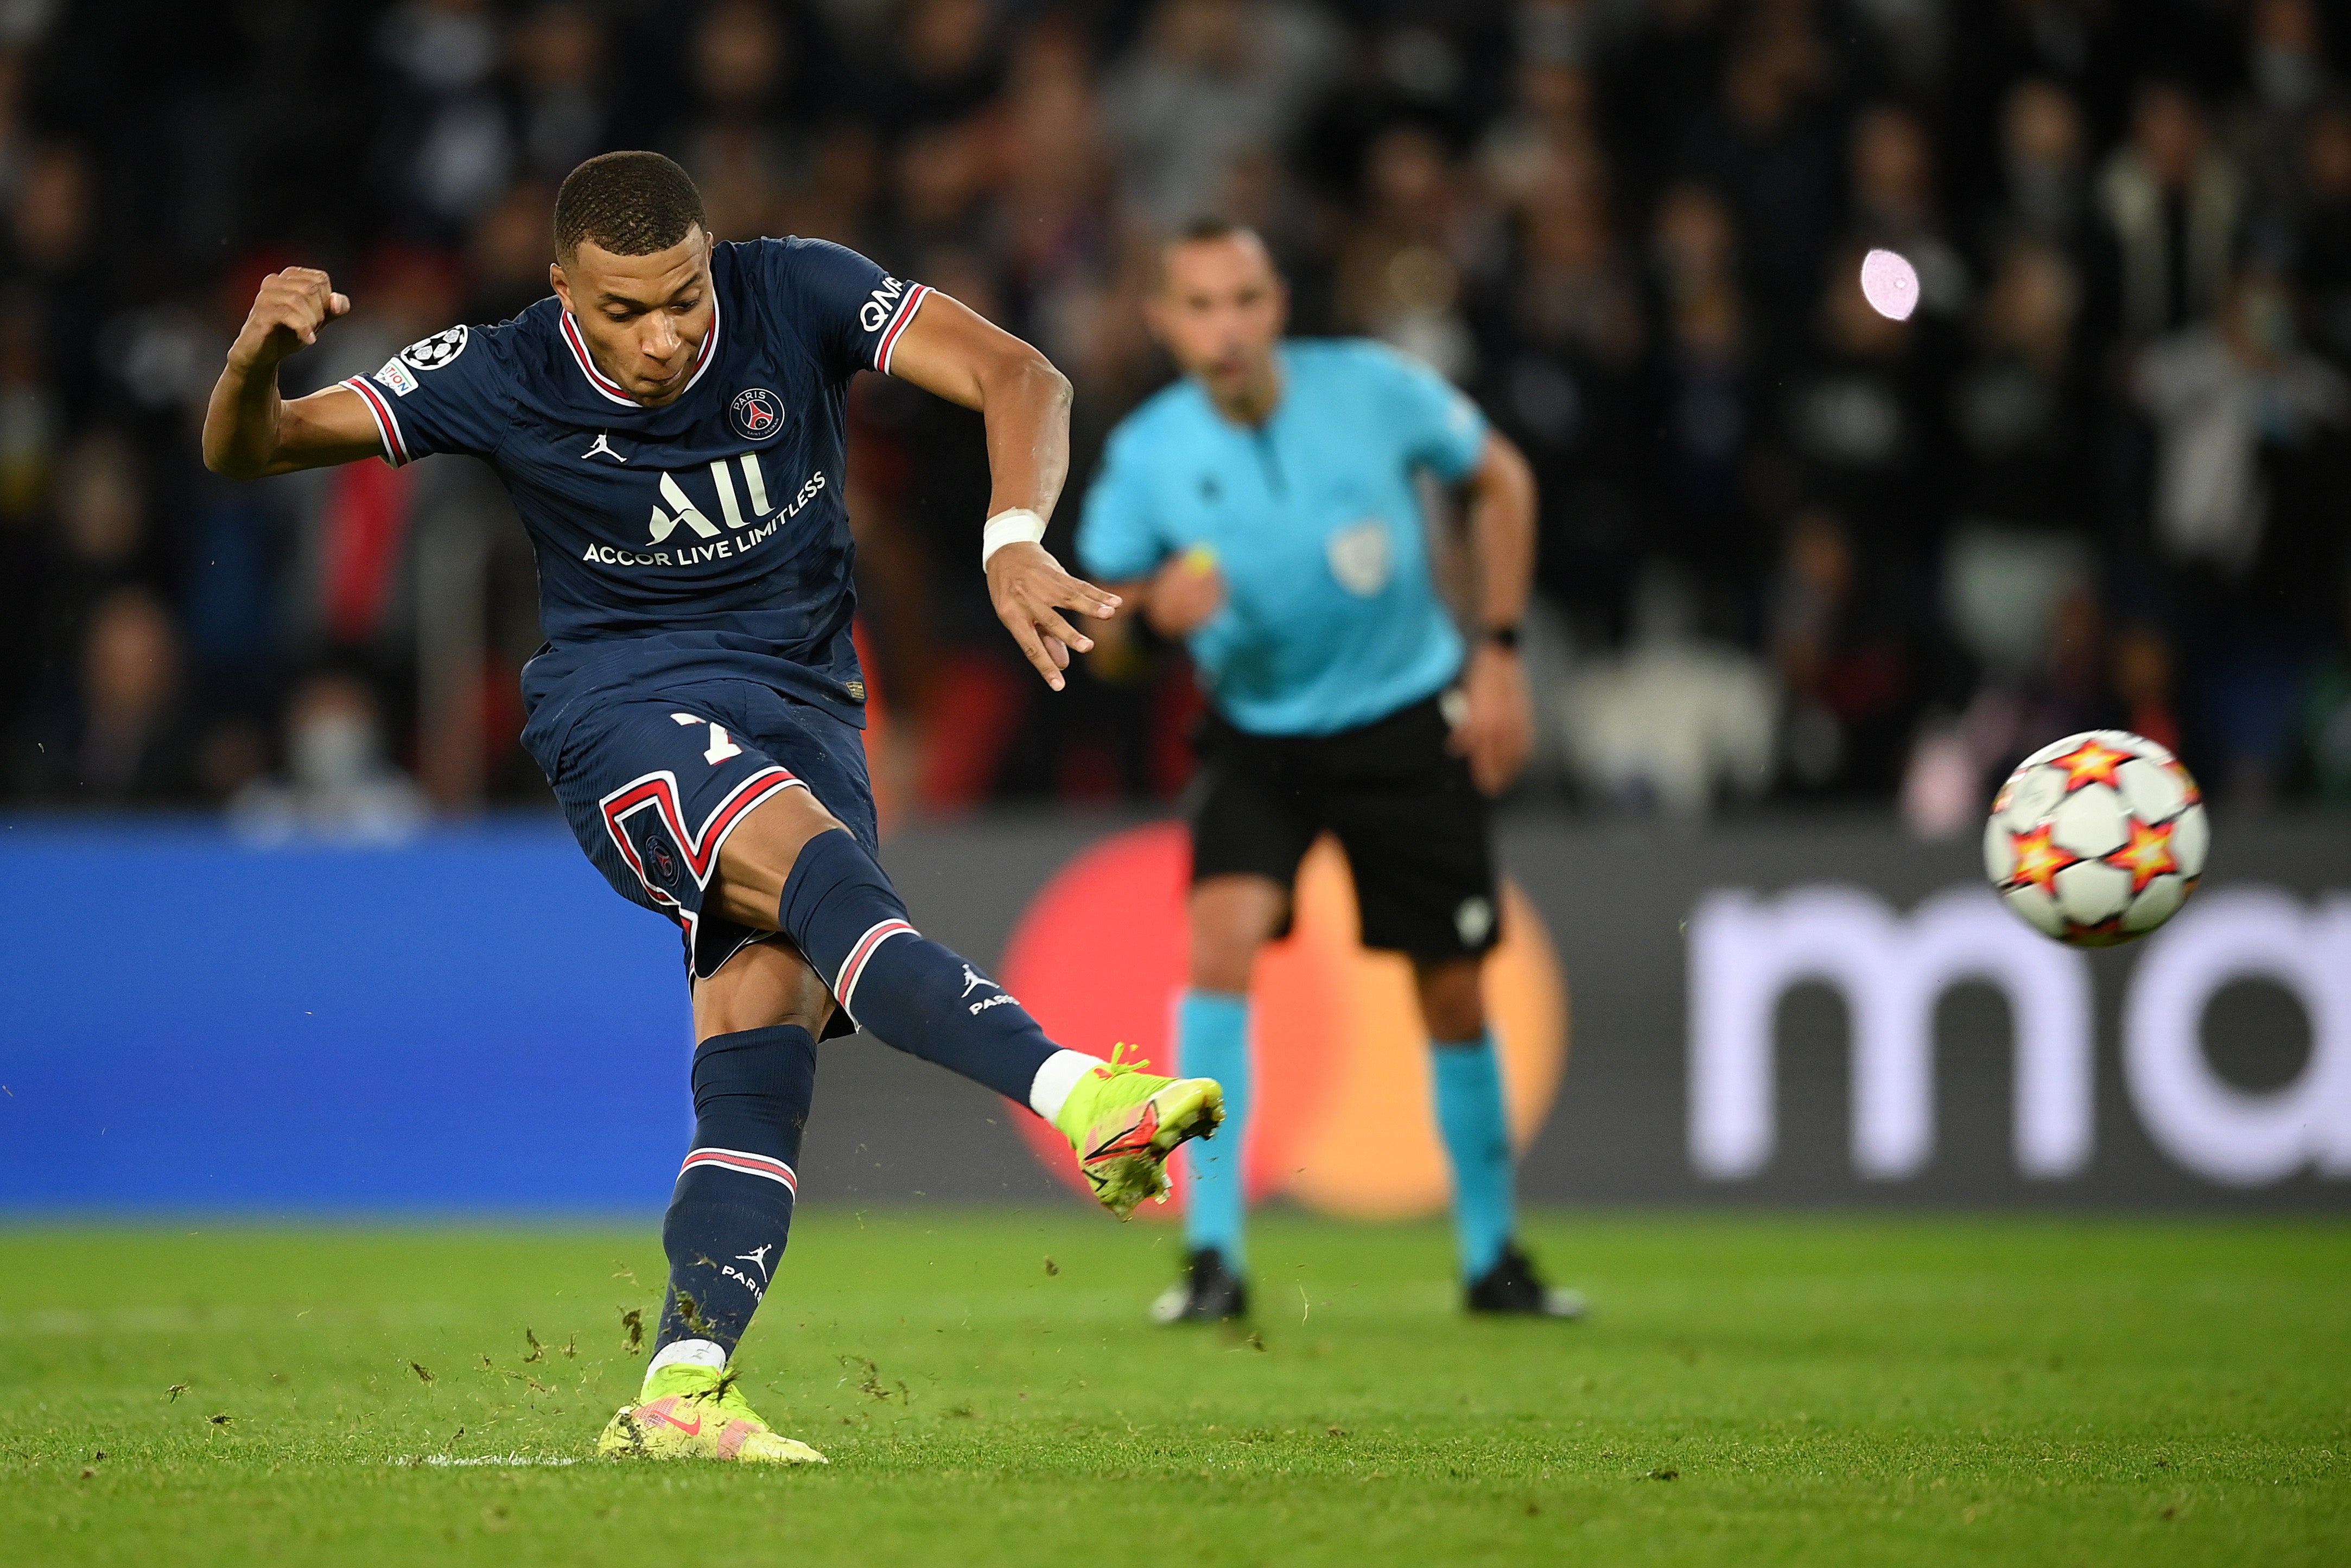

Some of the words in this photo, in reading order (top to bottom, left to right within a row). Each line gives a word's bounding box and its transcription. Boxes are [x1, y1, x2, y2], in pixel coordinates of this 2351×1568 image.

[733, 391, 766, 410] PARIS
[583, 543, 672, 566] ACCOR
[677, 541, 732, 566] LIVE
[736, 471, 825, 553] LIMITLESS
